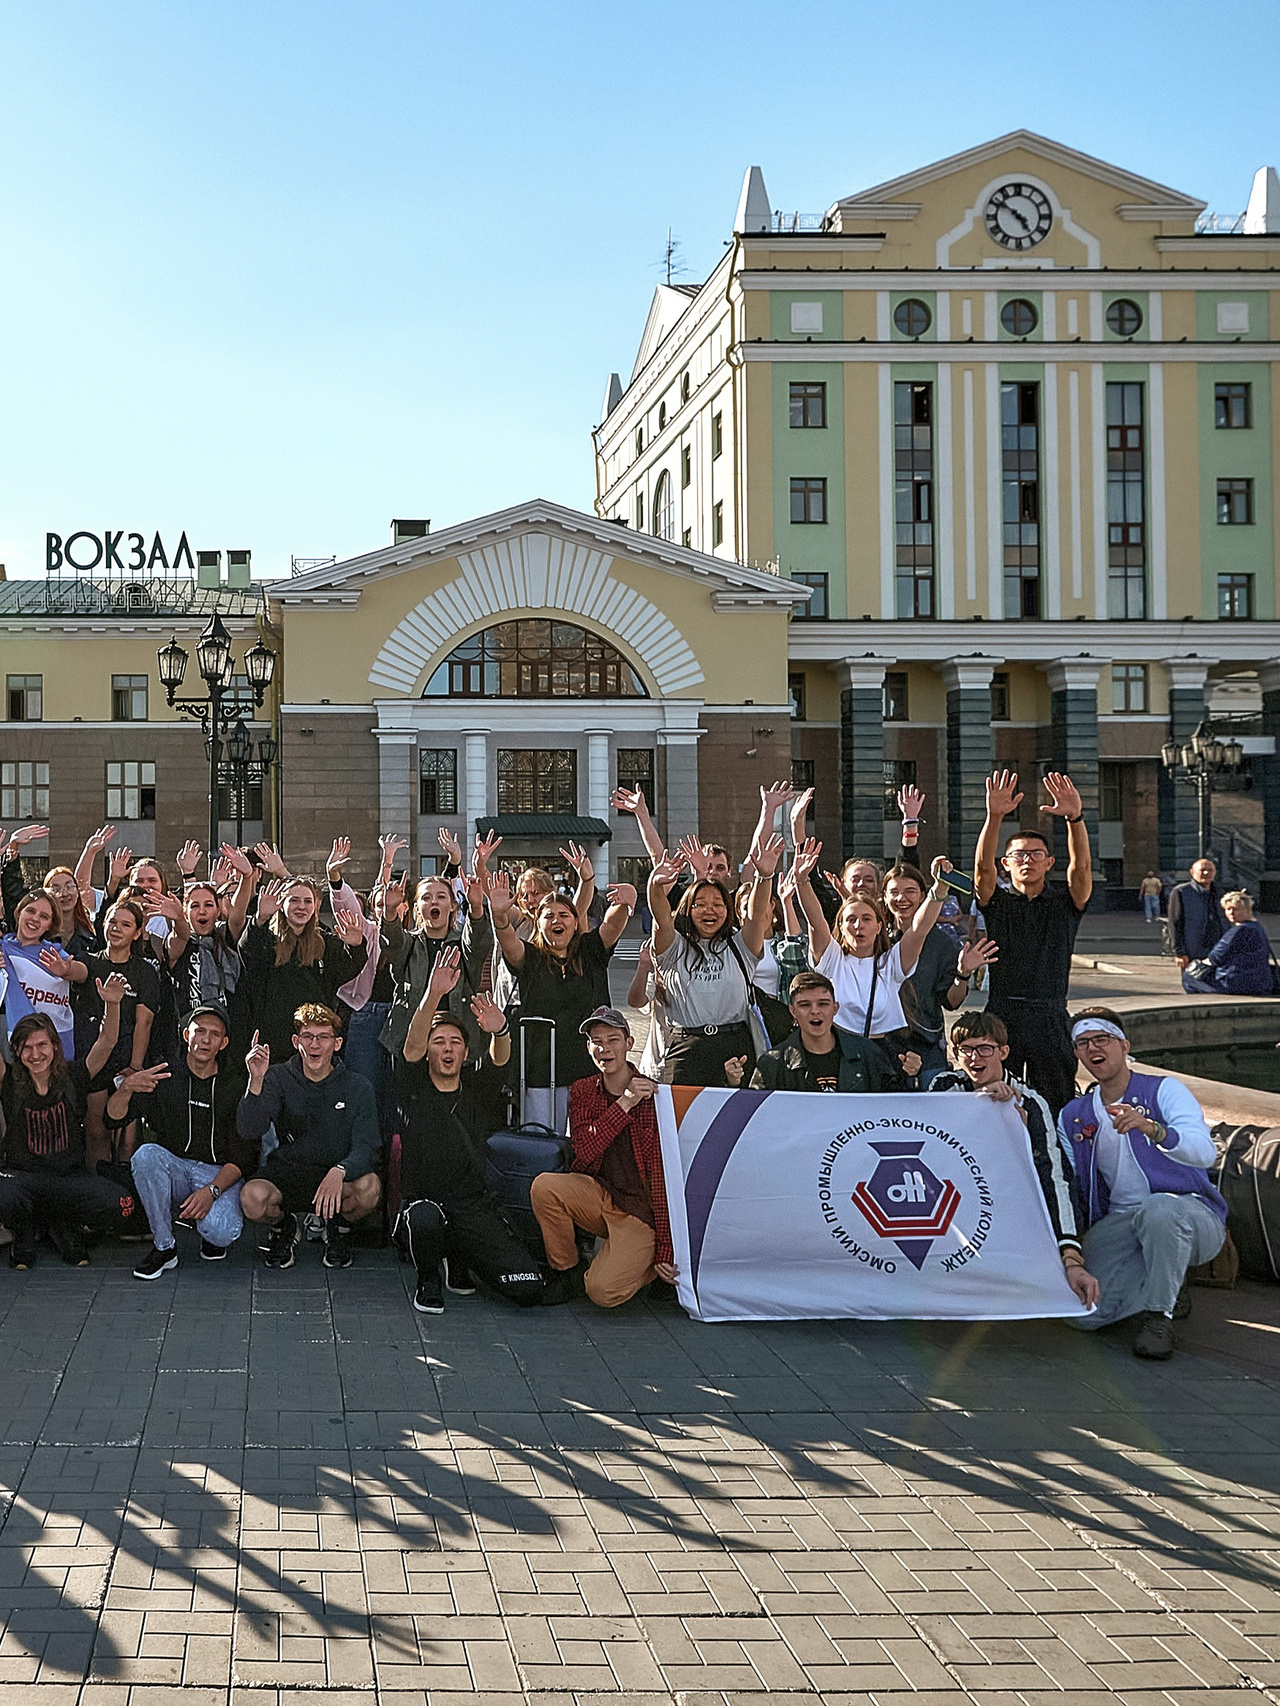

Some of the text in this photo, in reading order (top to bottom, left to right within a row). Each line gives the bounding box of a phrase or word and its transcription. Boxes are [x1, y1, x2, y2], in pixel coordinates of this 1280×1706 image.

[46, 530, 195, 570] ВОКЗАЛ
[818, 1118, 995, 1274] ОМСКИЙ ПРОМЫШЛЕННО-ЭКОНОМИЧЕСКИЙ КОЛЛЕДЖ
